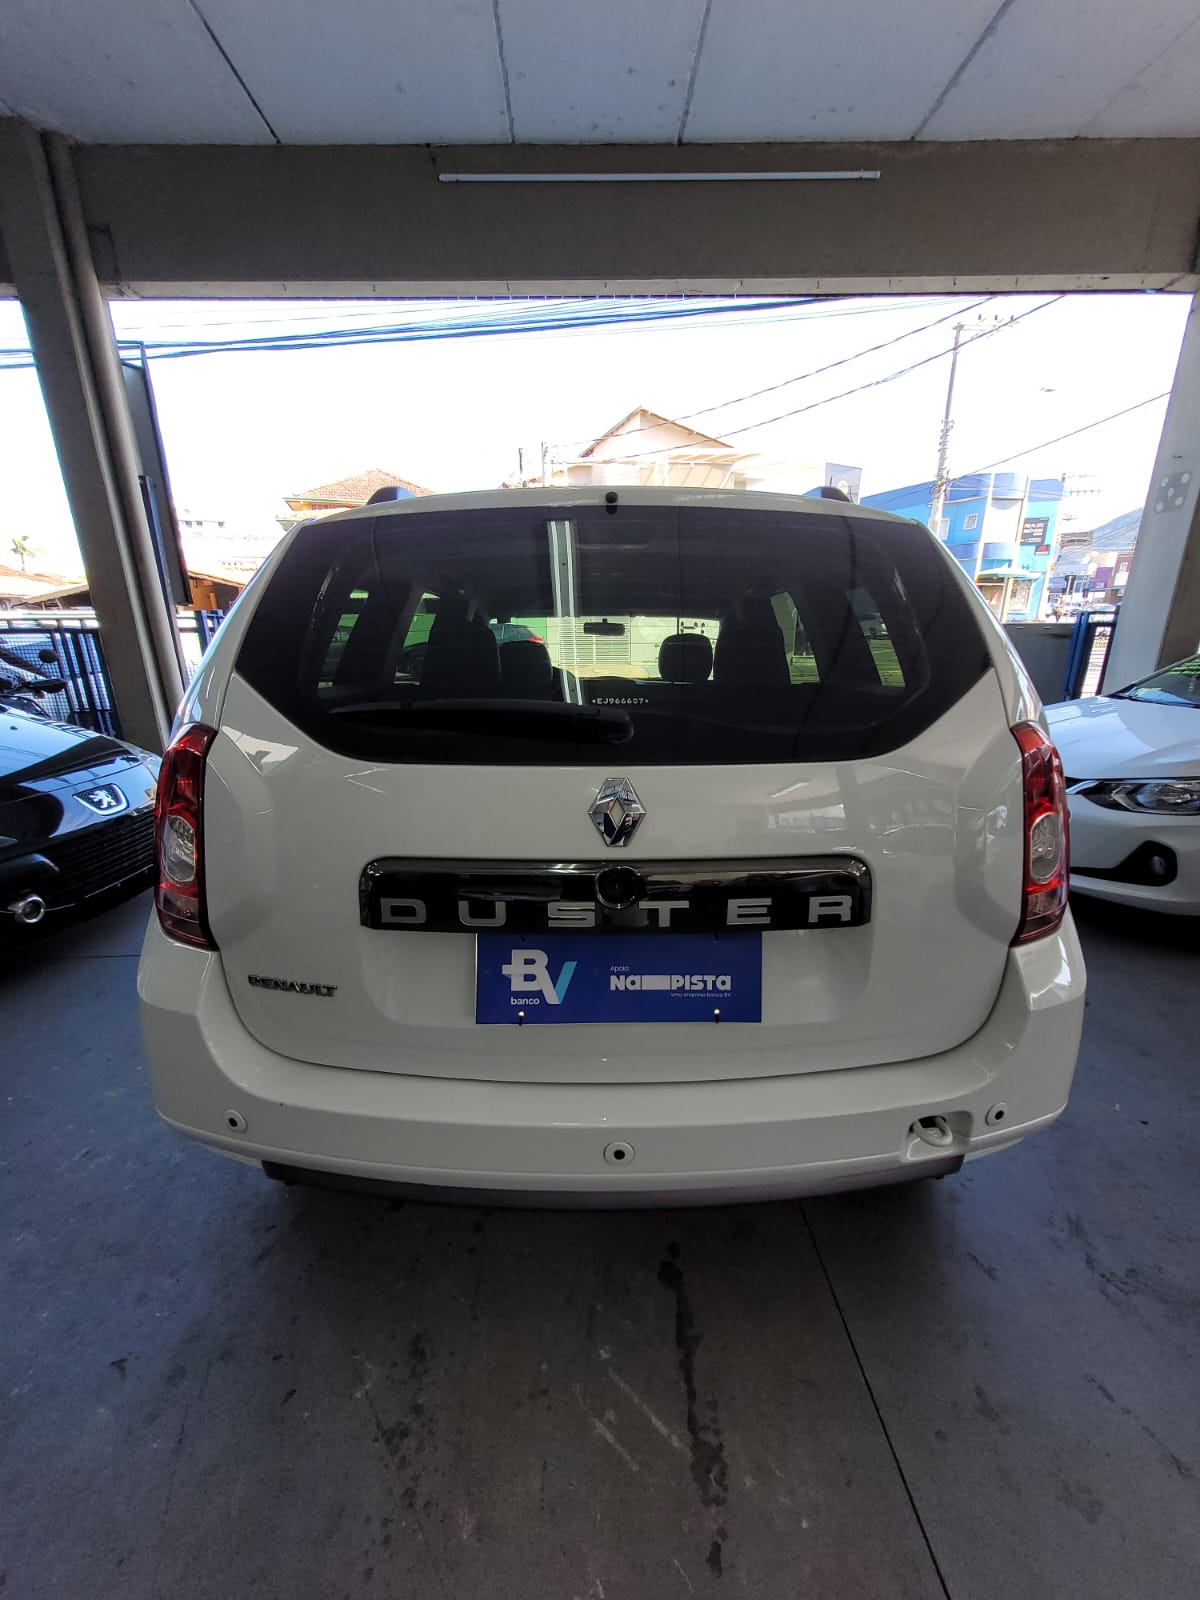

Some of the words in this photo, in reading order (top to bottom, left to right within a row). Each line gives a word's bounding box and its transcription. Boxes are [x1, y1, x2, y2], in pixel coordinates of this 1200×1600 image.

[380, 895, 854, 928] DUSTER
[248, 973, 338, 997] RENAULT
[510, 995, 540, 1006] banco
